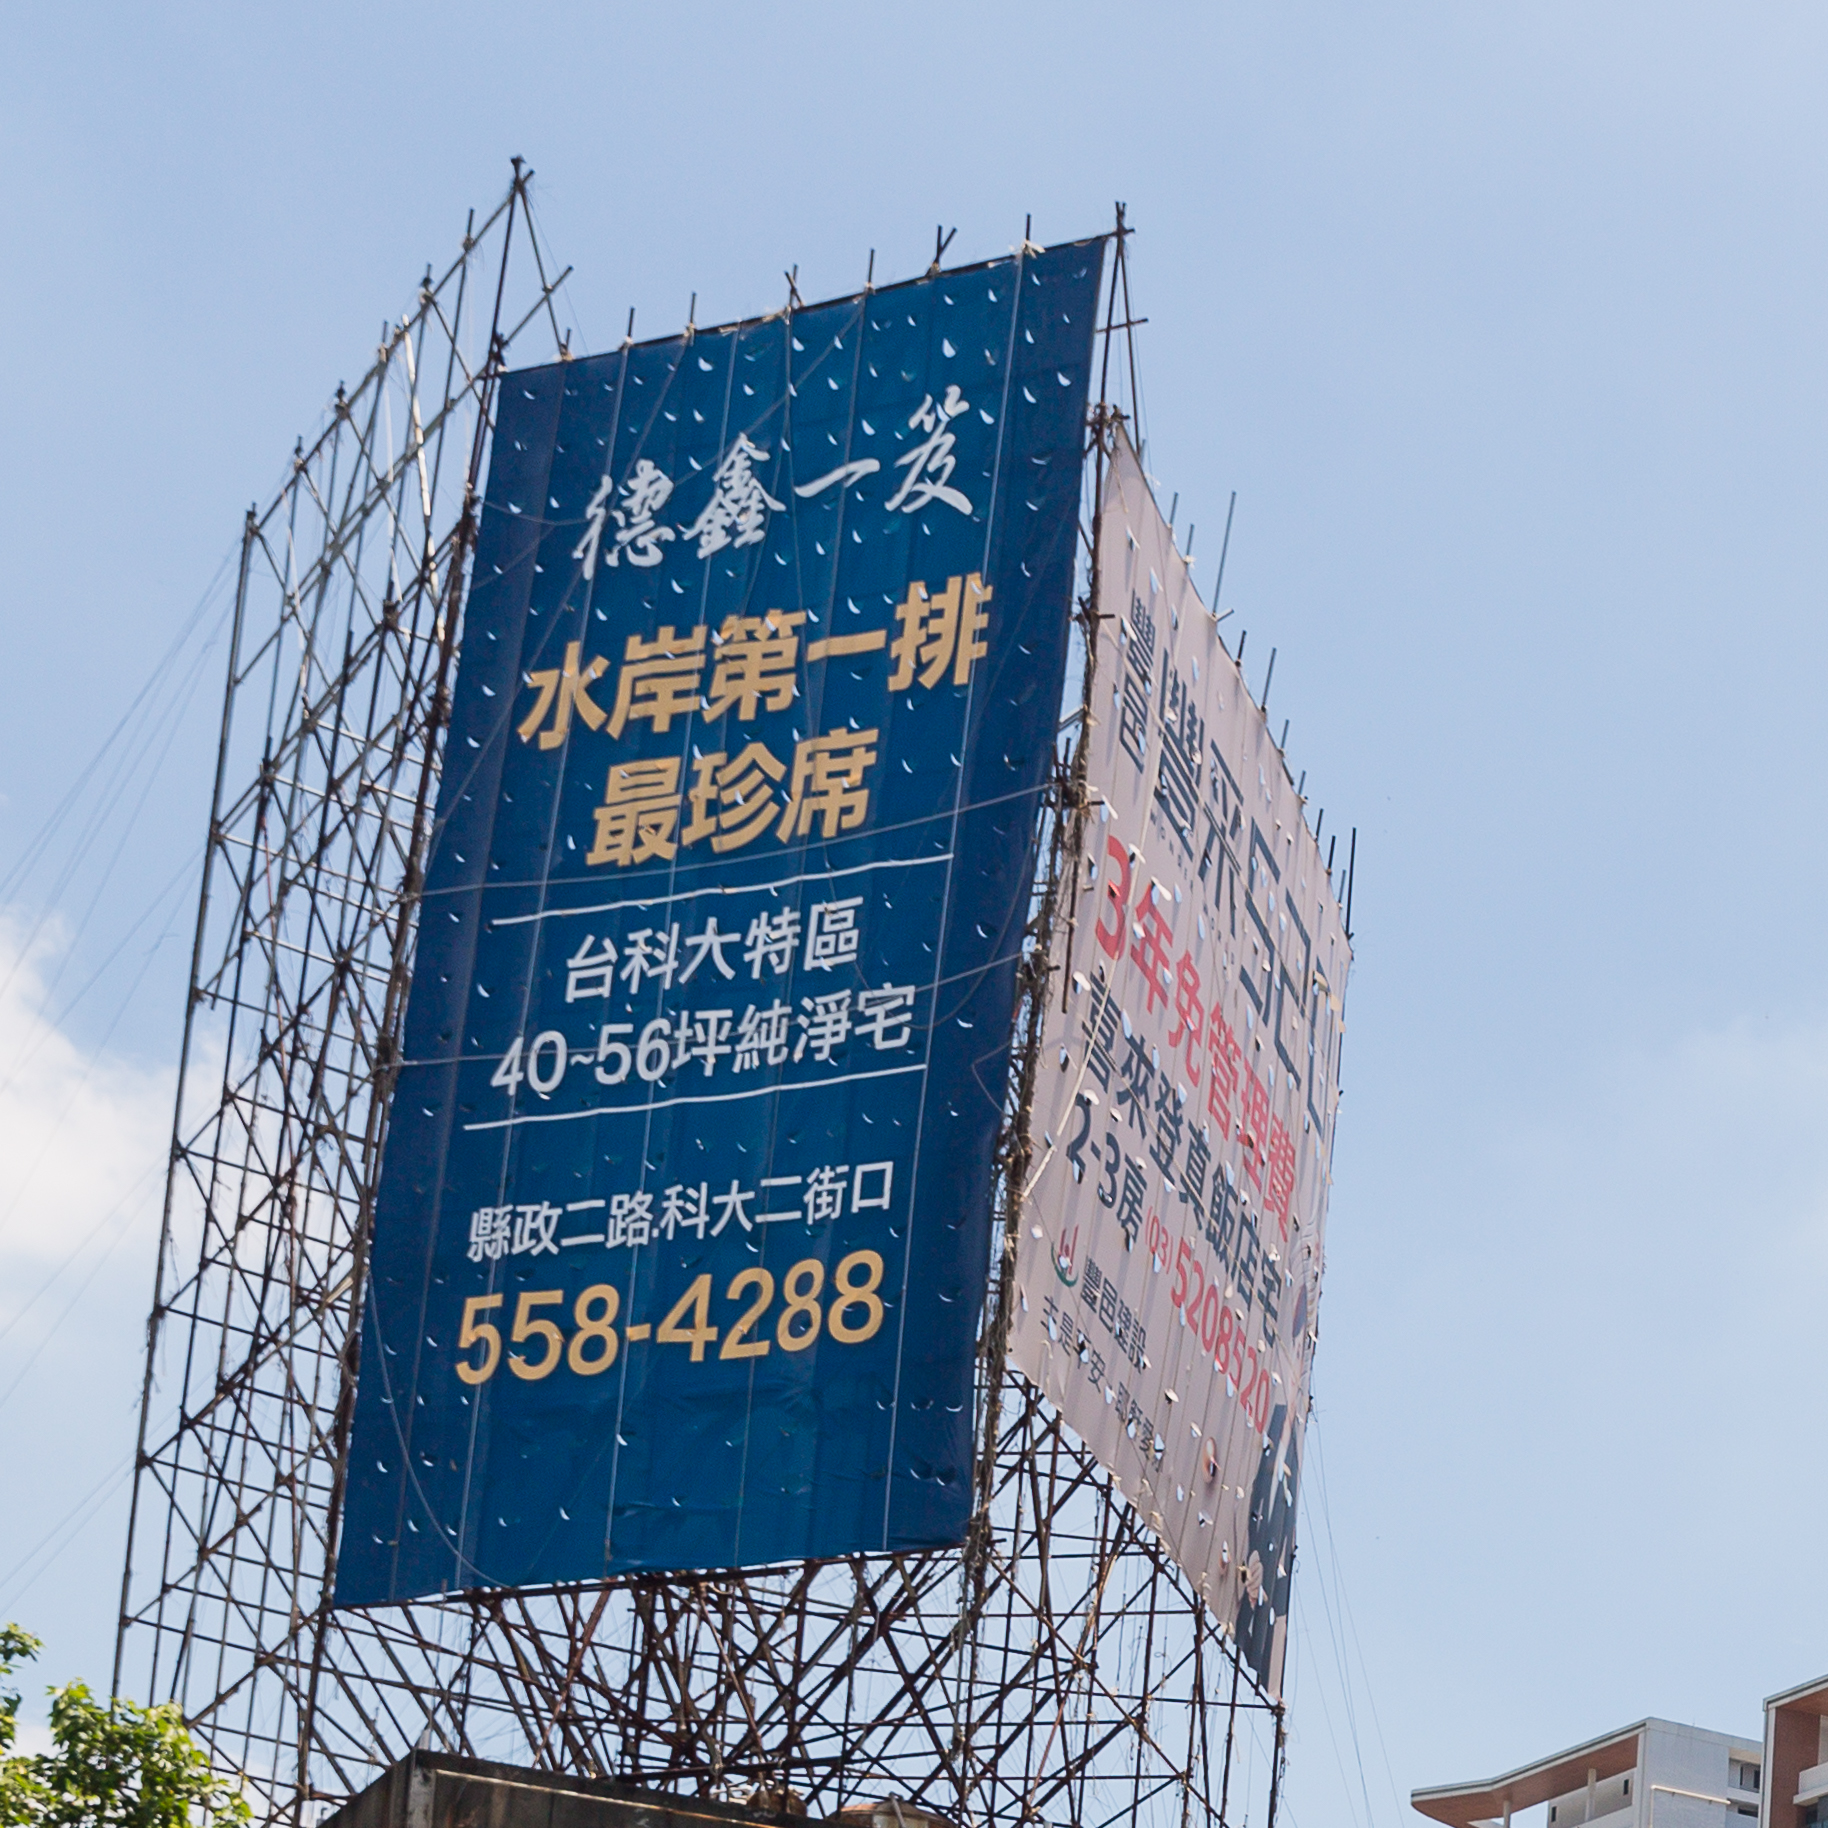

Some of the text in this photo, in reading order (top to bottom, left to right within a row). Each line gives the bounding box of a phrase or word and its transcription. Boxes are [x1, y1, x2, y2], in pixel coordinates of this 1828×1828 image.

[516, 571, 993, 752] 水岸第一排
[586, 728, 878, 869] 最珍席
[565, 897, 864, 1004] 台科大特區
[490, 981, 916, 1097] 40~56坪純淨宅
[1095, 836, 1296, 1244] 3年免管理費
[455, 1250, 885, 1387] 558-4288
